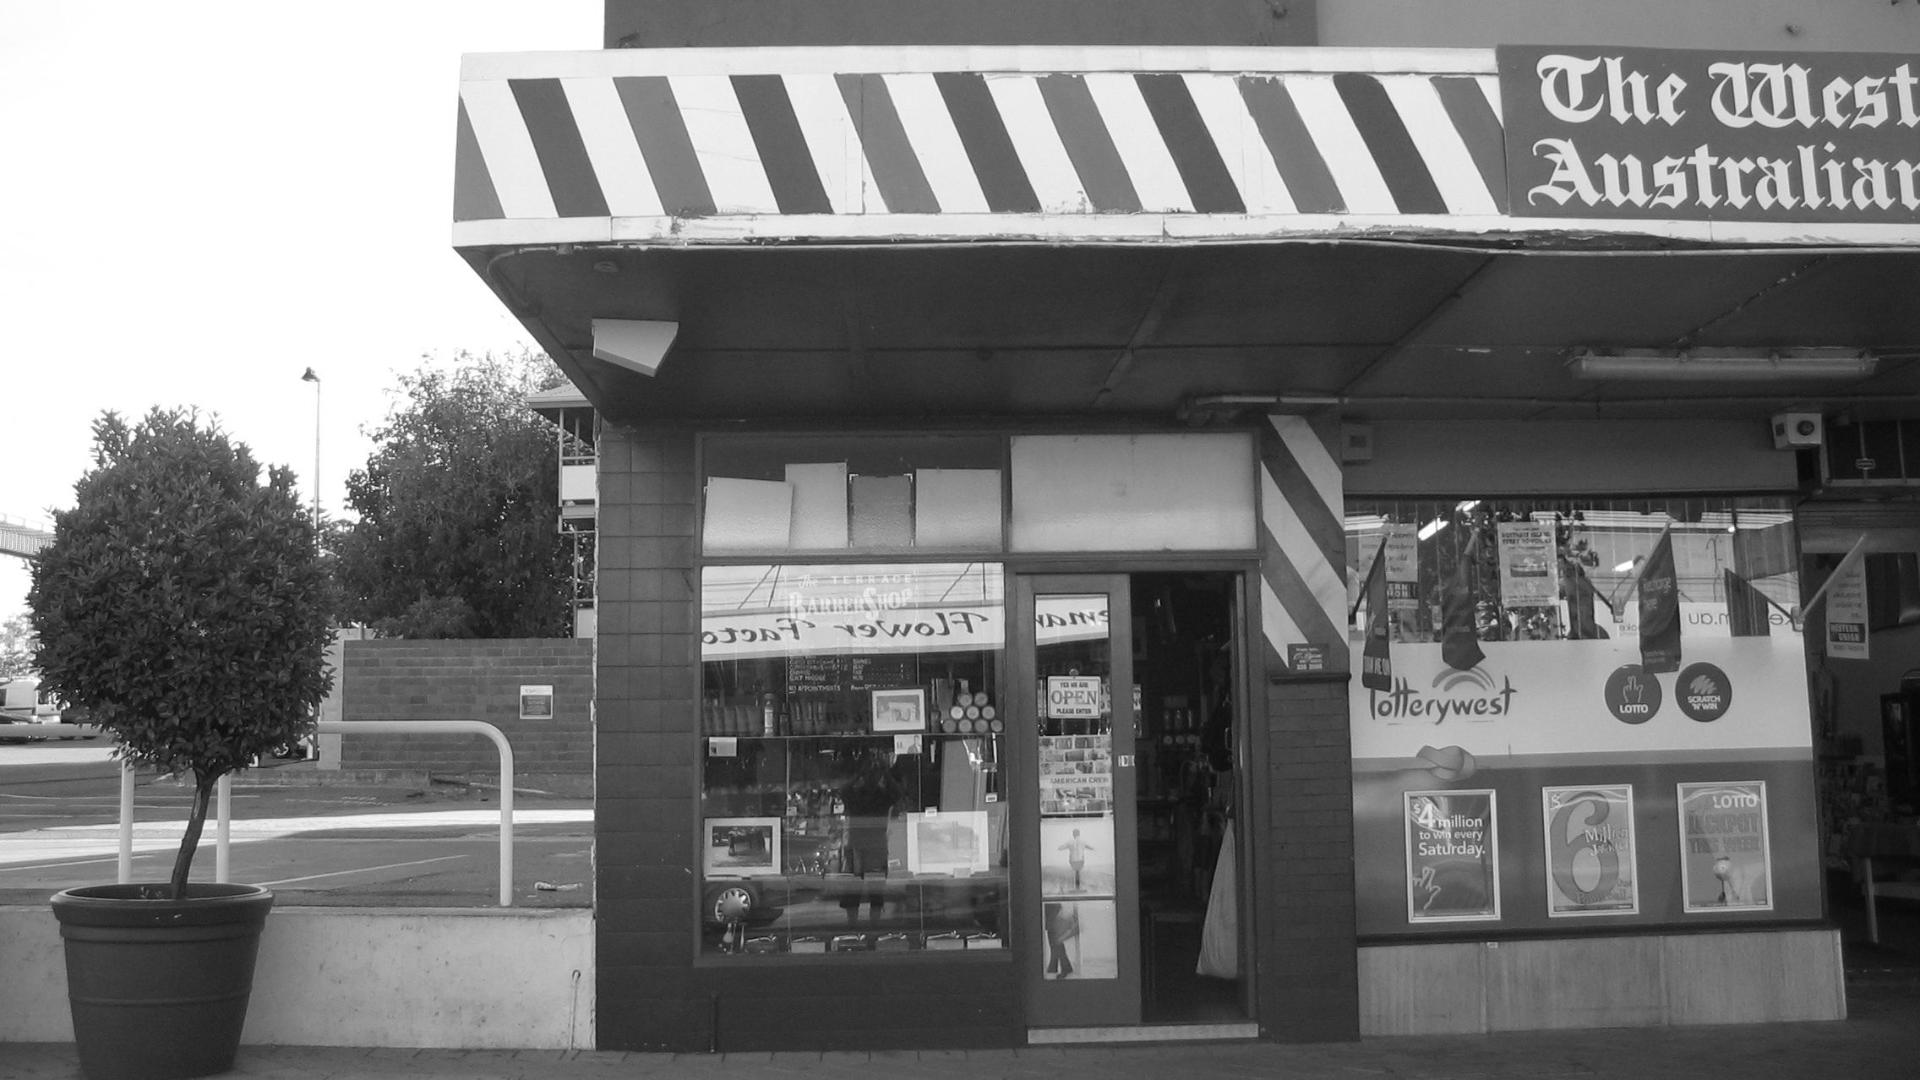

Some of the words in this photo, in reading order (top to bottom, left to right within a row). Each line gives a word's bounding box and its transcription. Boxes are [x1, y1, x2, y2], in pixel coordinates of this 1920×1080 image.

[1536, 54, 1688, 126] The
[1708, 62, 1919, 129] West
[830, 574, 912, 585] TERRACE
[1051, 690, 1097, 705] OPEN
[1370, 675, 1518, 725] lotterywest
[1687, 695, 1721, 704] SCRATCH
[1619, 704, 1649, 714] LOTTO
[1703, 702, 1718, 711] WIN
[1712, 794, 1759, 809] LOTTO
[1437, 814, 1483, 829] million
[1419, 831, 1431, 840] to
[1433, 830, 1452, 840] win
[1454, 830, 1483, 842] every
[1418, 841, 1486, 858] Saturday.
